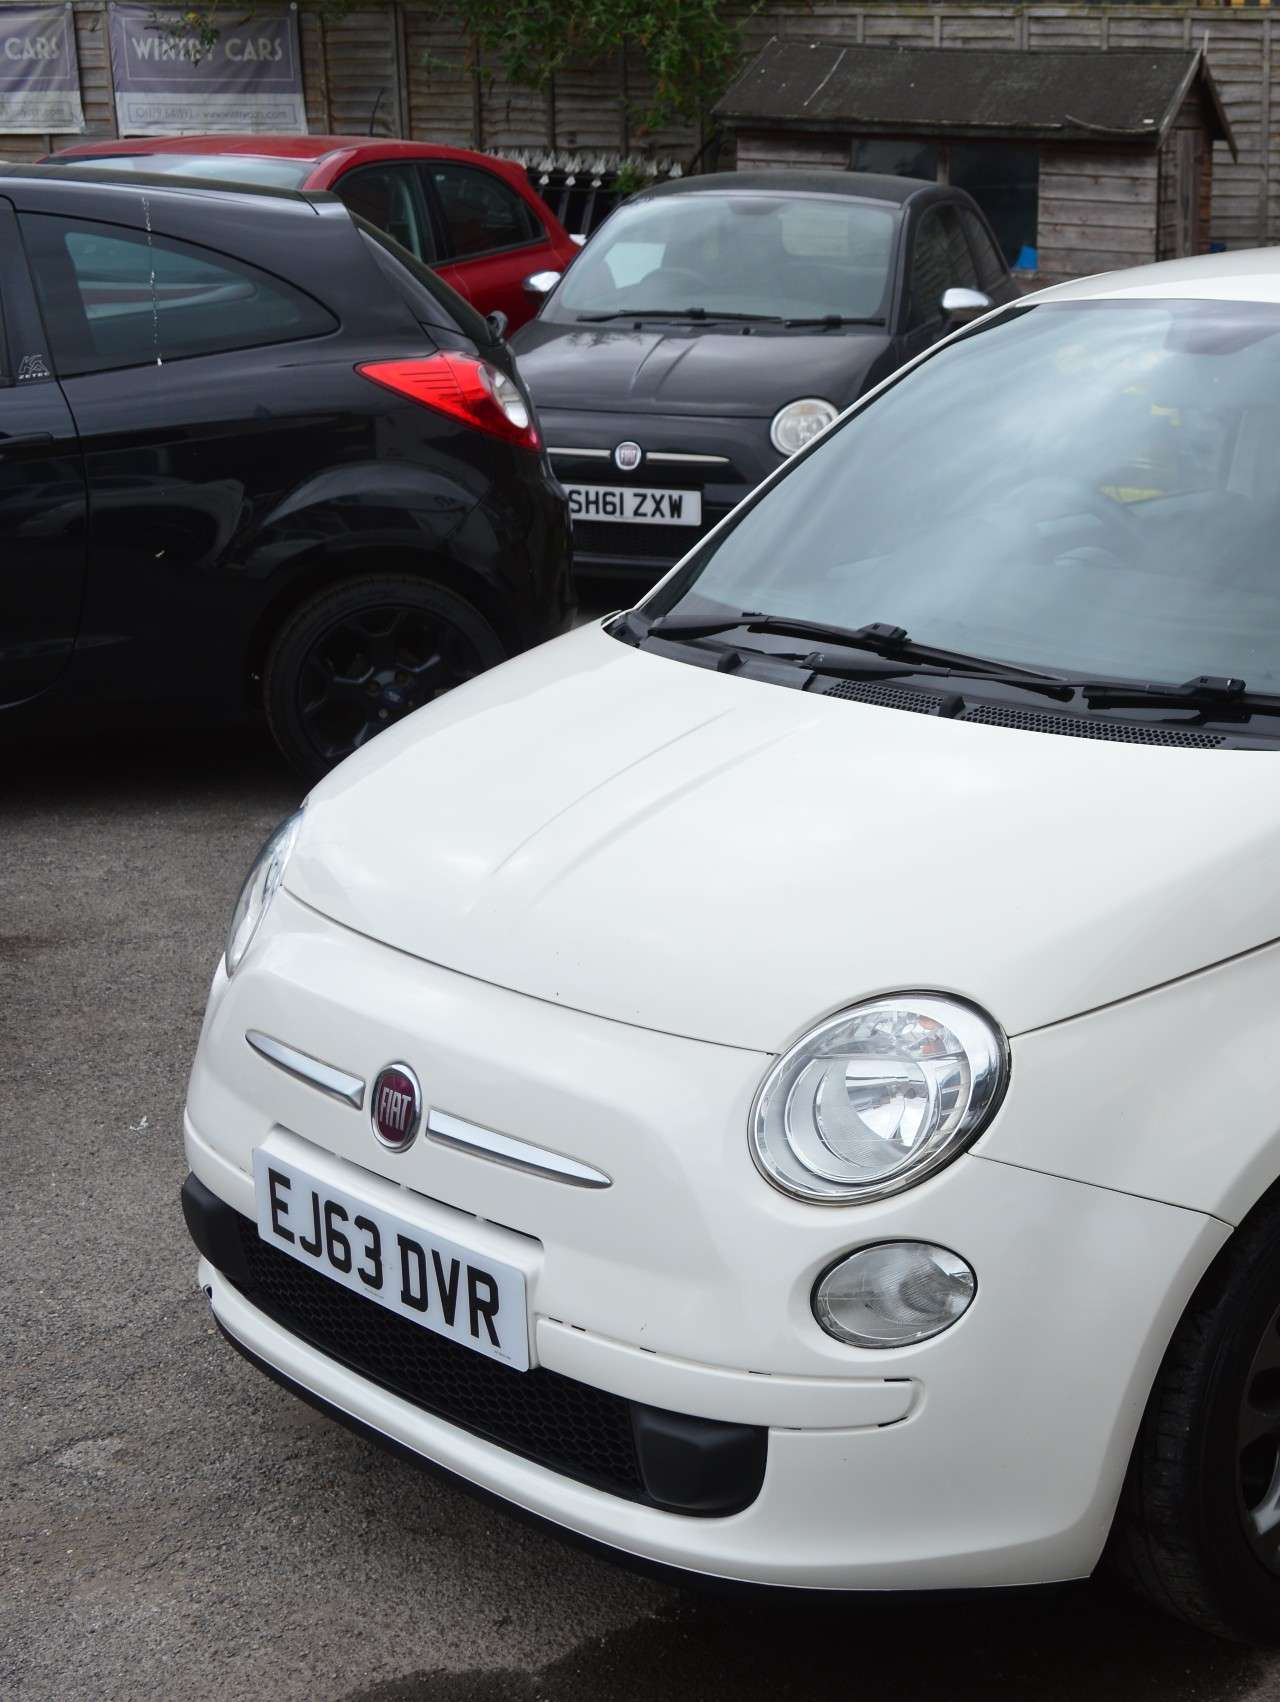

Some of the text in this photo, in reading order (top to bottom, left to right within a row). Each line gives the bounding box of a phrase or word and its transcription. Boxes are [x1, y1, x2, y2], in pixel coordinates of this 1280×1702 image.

[5, 37, 59, 60] CARS
[225, 38, 283, 62] CARS
[568, 489, 683, 519] SH61 ZXW
[380, 1086, 411, 1130] FIAT
[267, 1167, 501, 1349] EJ63 DVR
